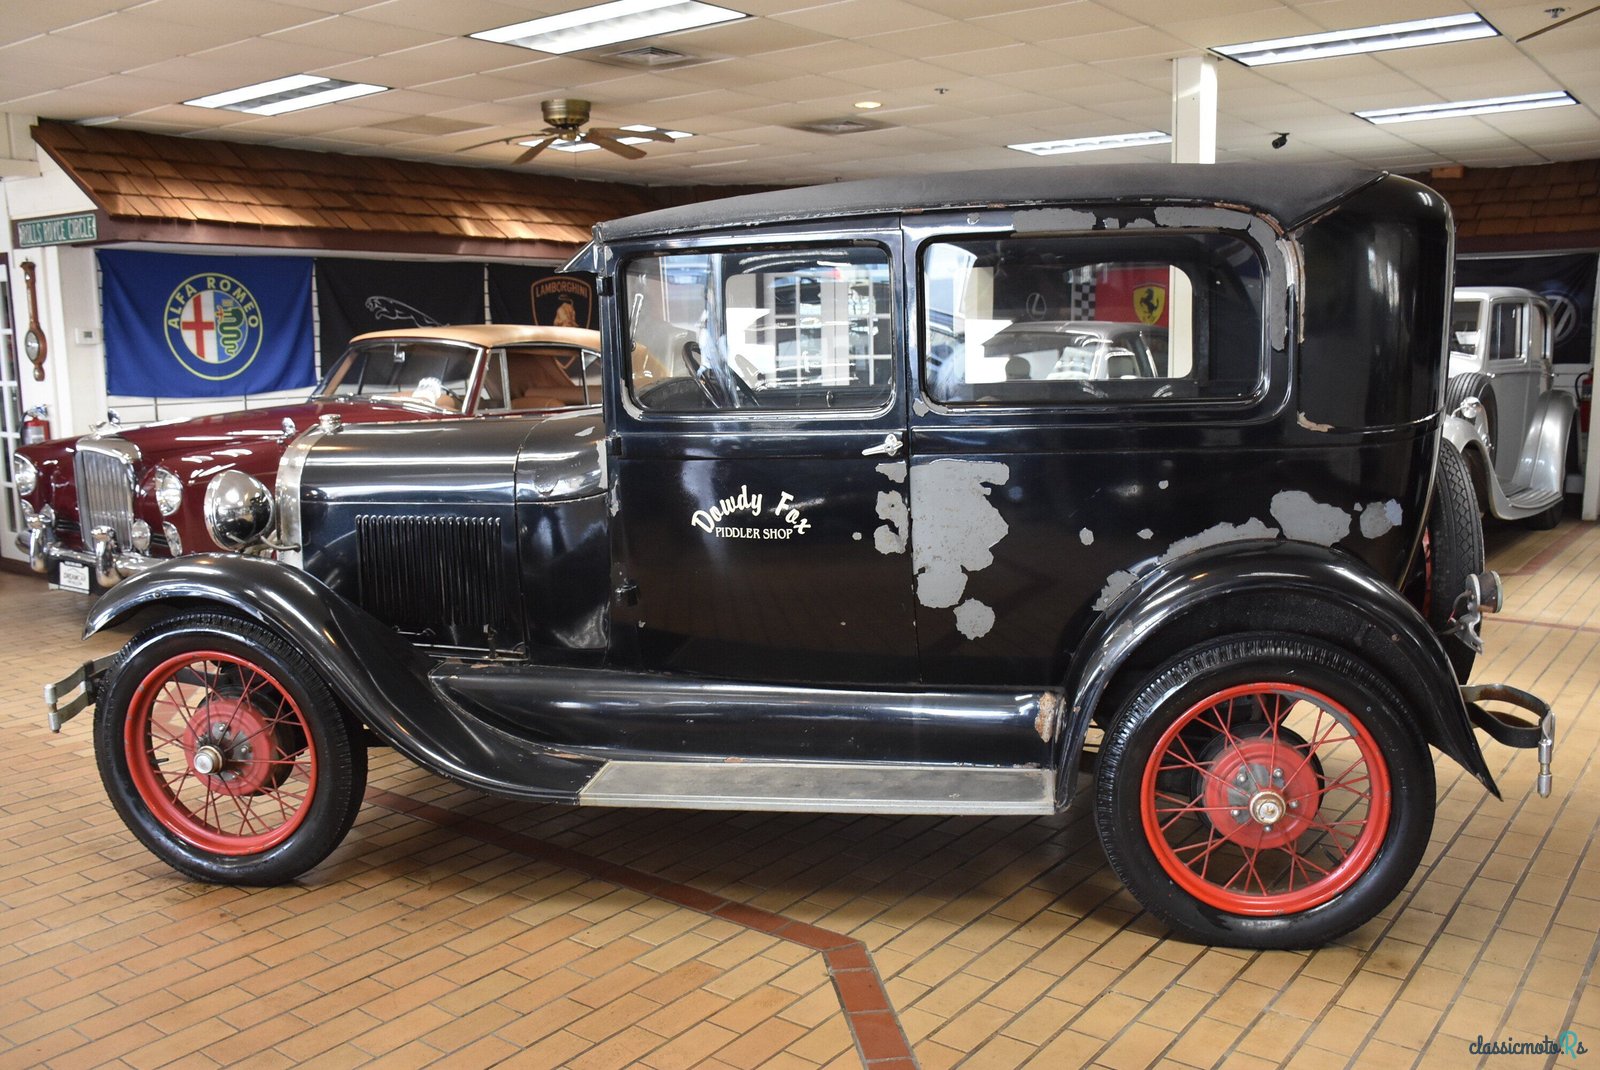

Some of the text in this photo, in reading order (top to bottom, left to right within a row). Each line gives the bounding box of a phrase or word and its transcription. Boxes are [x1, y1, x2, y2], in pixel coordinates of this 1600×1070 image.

[20, 217, 93, 243] ROLLS ROYCE CIRCLE
[535, 281, 588, 298] LAMBORGHINI
[167, 276, 260, 330] ALFA ROMEO
[691, 484, 812, 535] Dowdy Fox
[715, 526, 793, 540] PIDDLER SHOP
